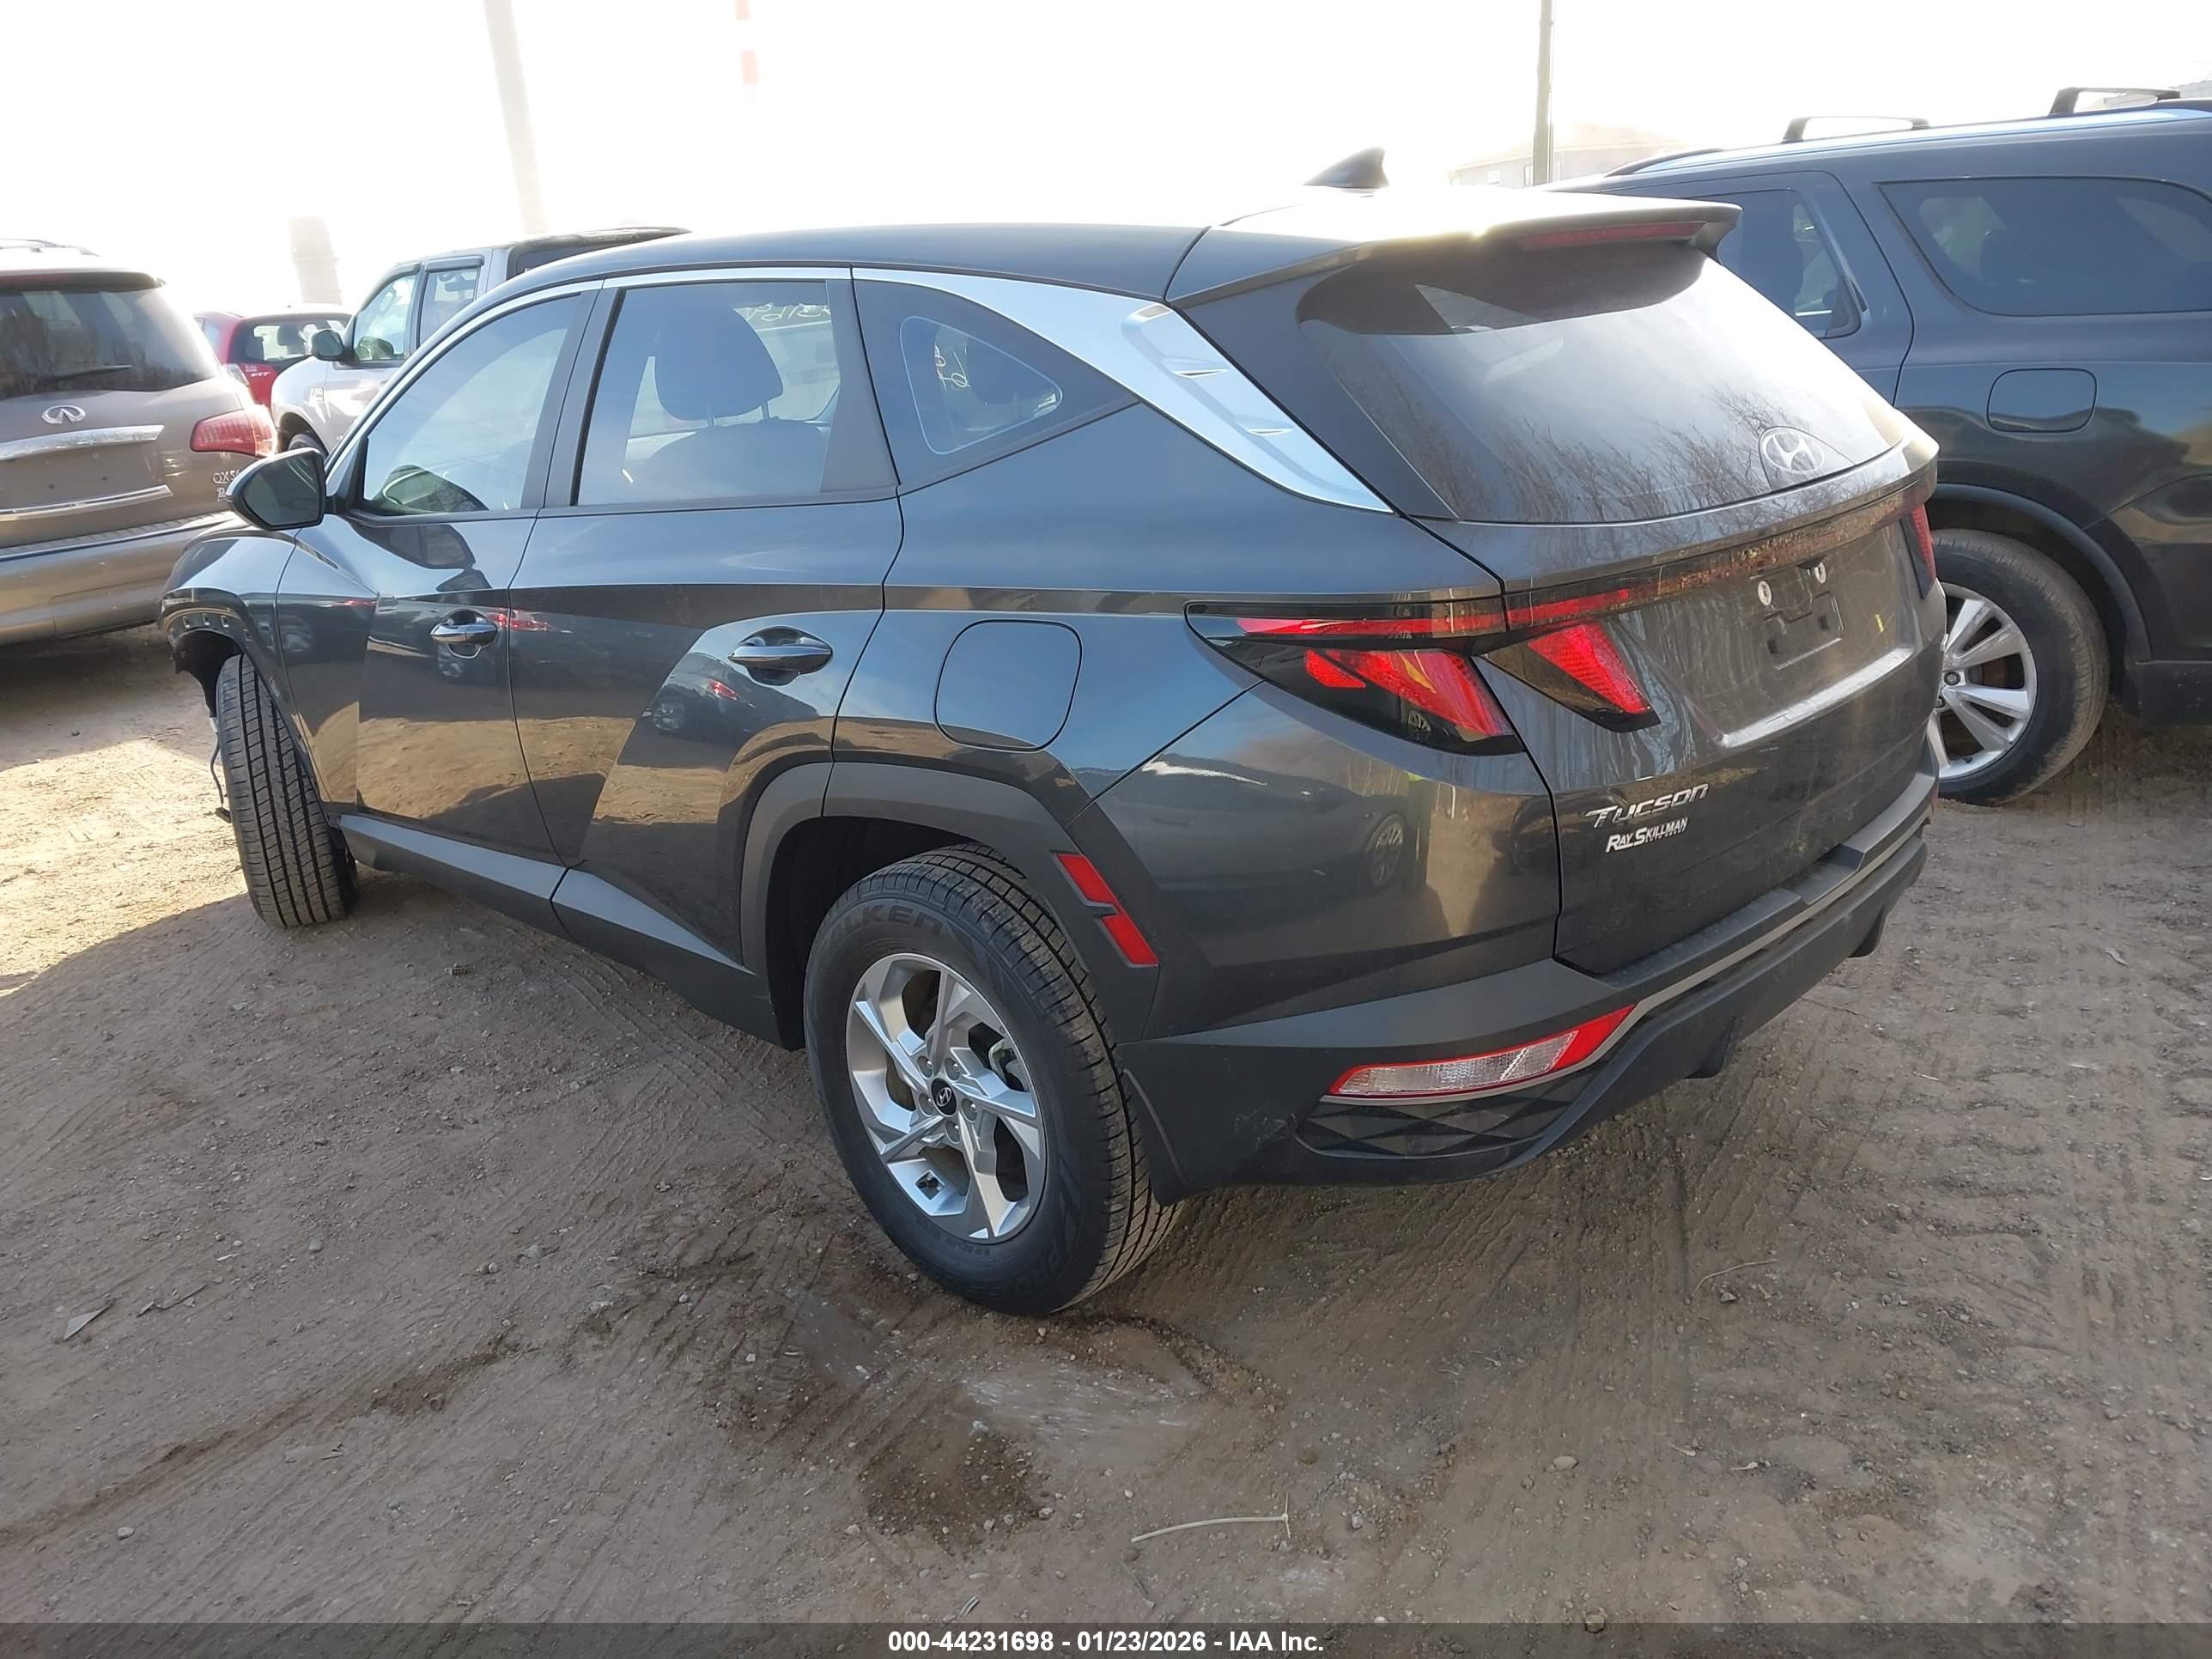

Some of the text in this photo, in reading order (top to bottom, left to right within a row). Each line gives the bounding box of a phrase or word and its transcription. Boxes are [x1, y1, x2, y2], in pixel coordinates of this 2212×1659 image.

[1585, 783, 1709, 828] TUCSON
[1605, 833, 1634, 853] RAY
[1633, 817, 1688, 846] SKILLMAN
